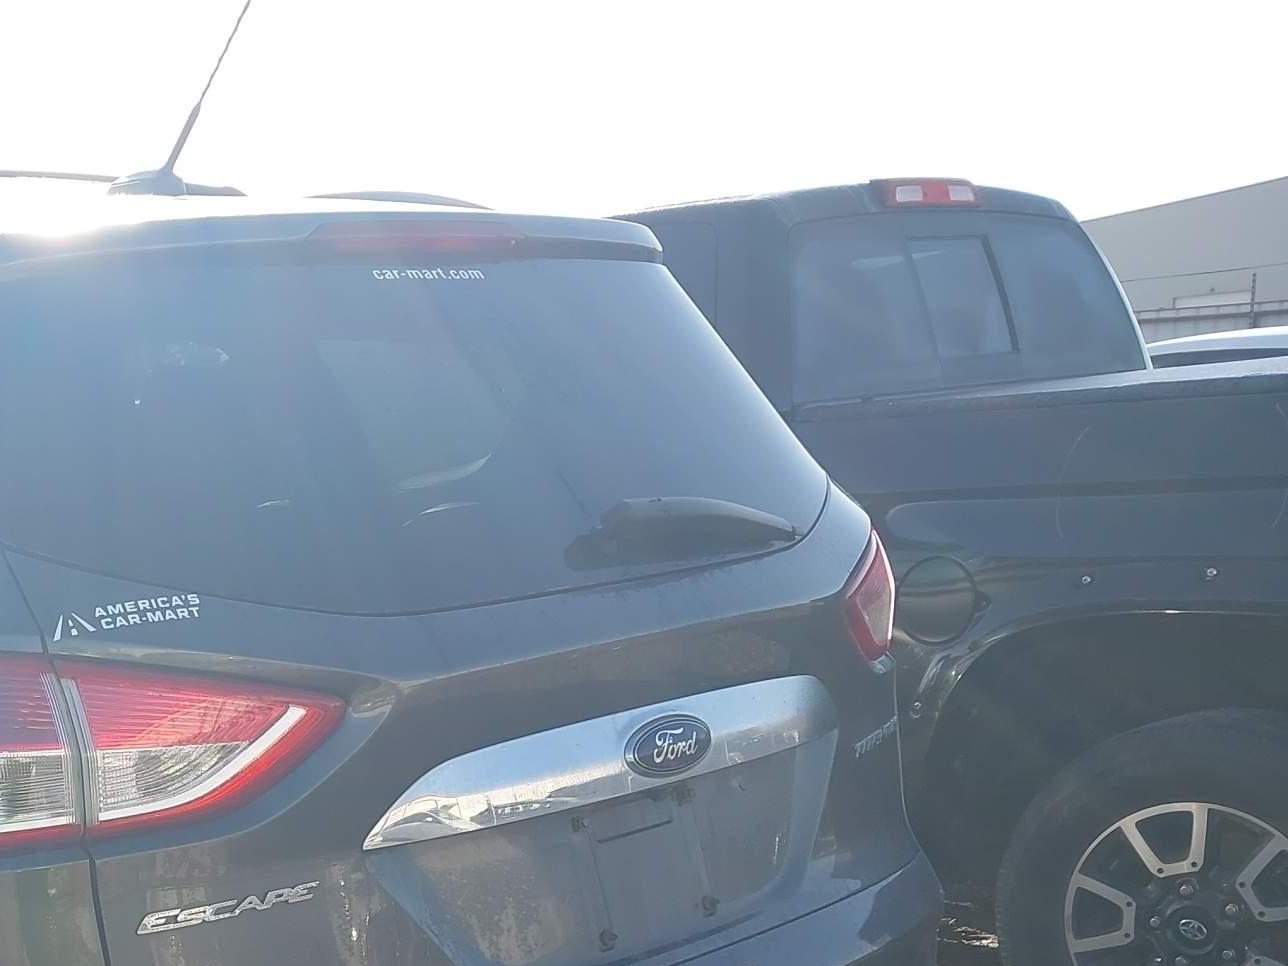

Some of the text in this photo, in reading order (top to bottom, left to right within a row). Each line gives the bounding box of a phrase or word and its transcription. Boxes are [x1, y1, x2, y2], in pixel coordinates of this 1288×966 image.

[372, 267, 485, 281] car-mart.com
[94, 593, 201, 618] AMERICA'S
[100, 606, 201, 630] CAR-MART
[653, 727, 698, 764] Ford
[136, 880, 320, 936] ESCAPE
